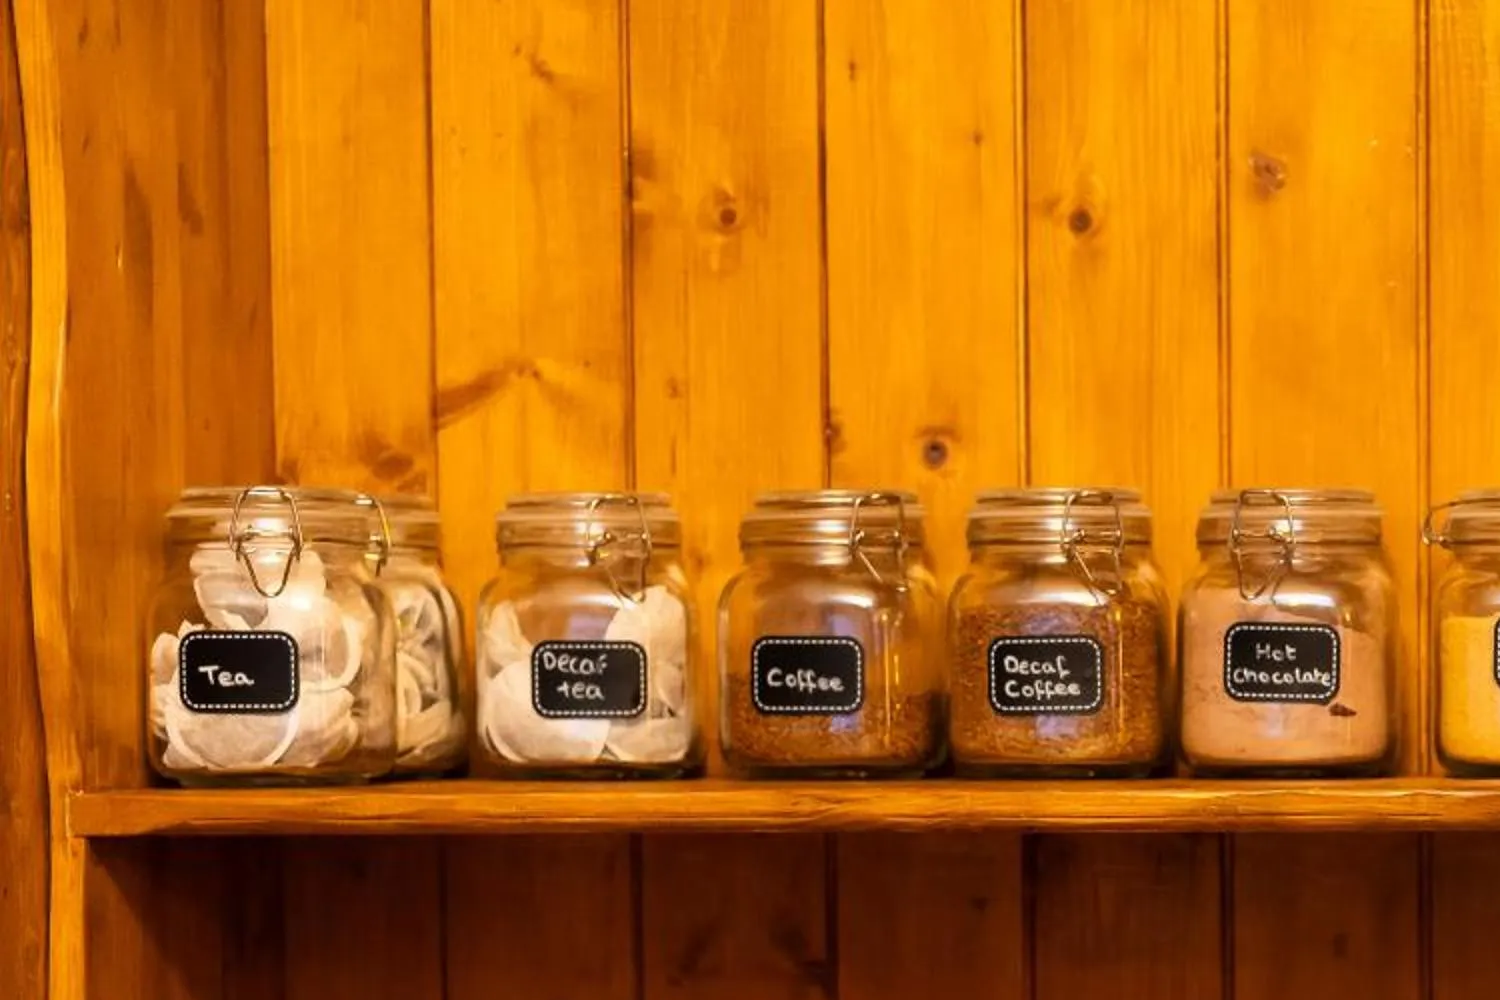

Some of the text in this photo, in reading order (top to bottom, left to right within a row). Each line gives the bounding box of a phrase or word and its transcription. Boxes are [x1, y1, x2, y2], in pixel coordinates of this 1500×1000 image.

[1256, 642, 1297, 662] Hot
[543, 651, 608, 675] Decaf
[1004, 656, 1069, 679] Decaf
[199, 665, 255, 687] Tea
[766, 668, 845, 693] Coffee
[1232, 667, 1332, 687] Chocolate
[556, 681, 605, 700] tea
[1004, 679, 1082, 699] Coffee
